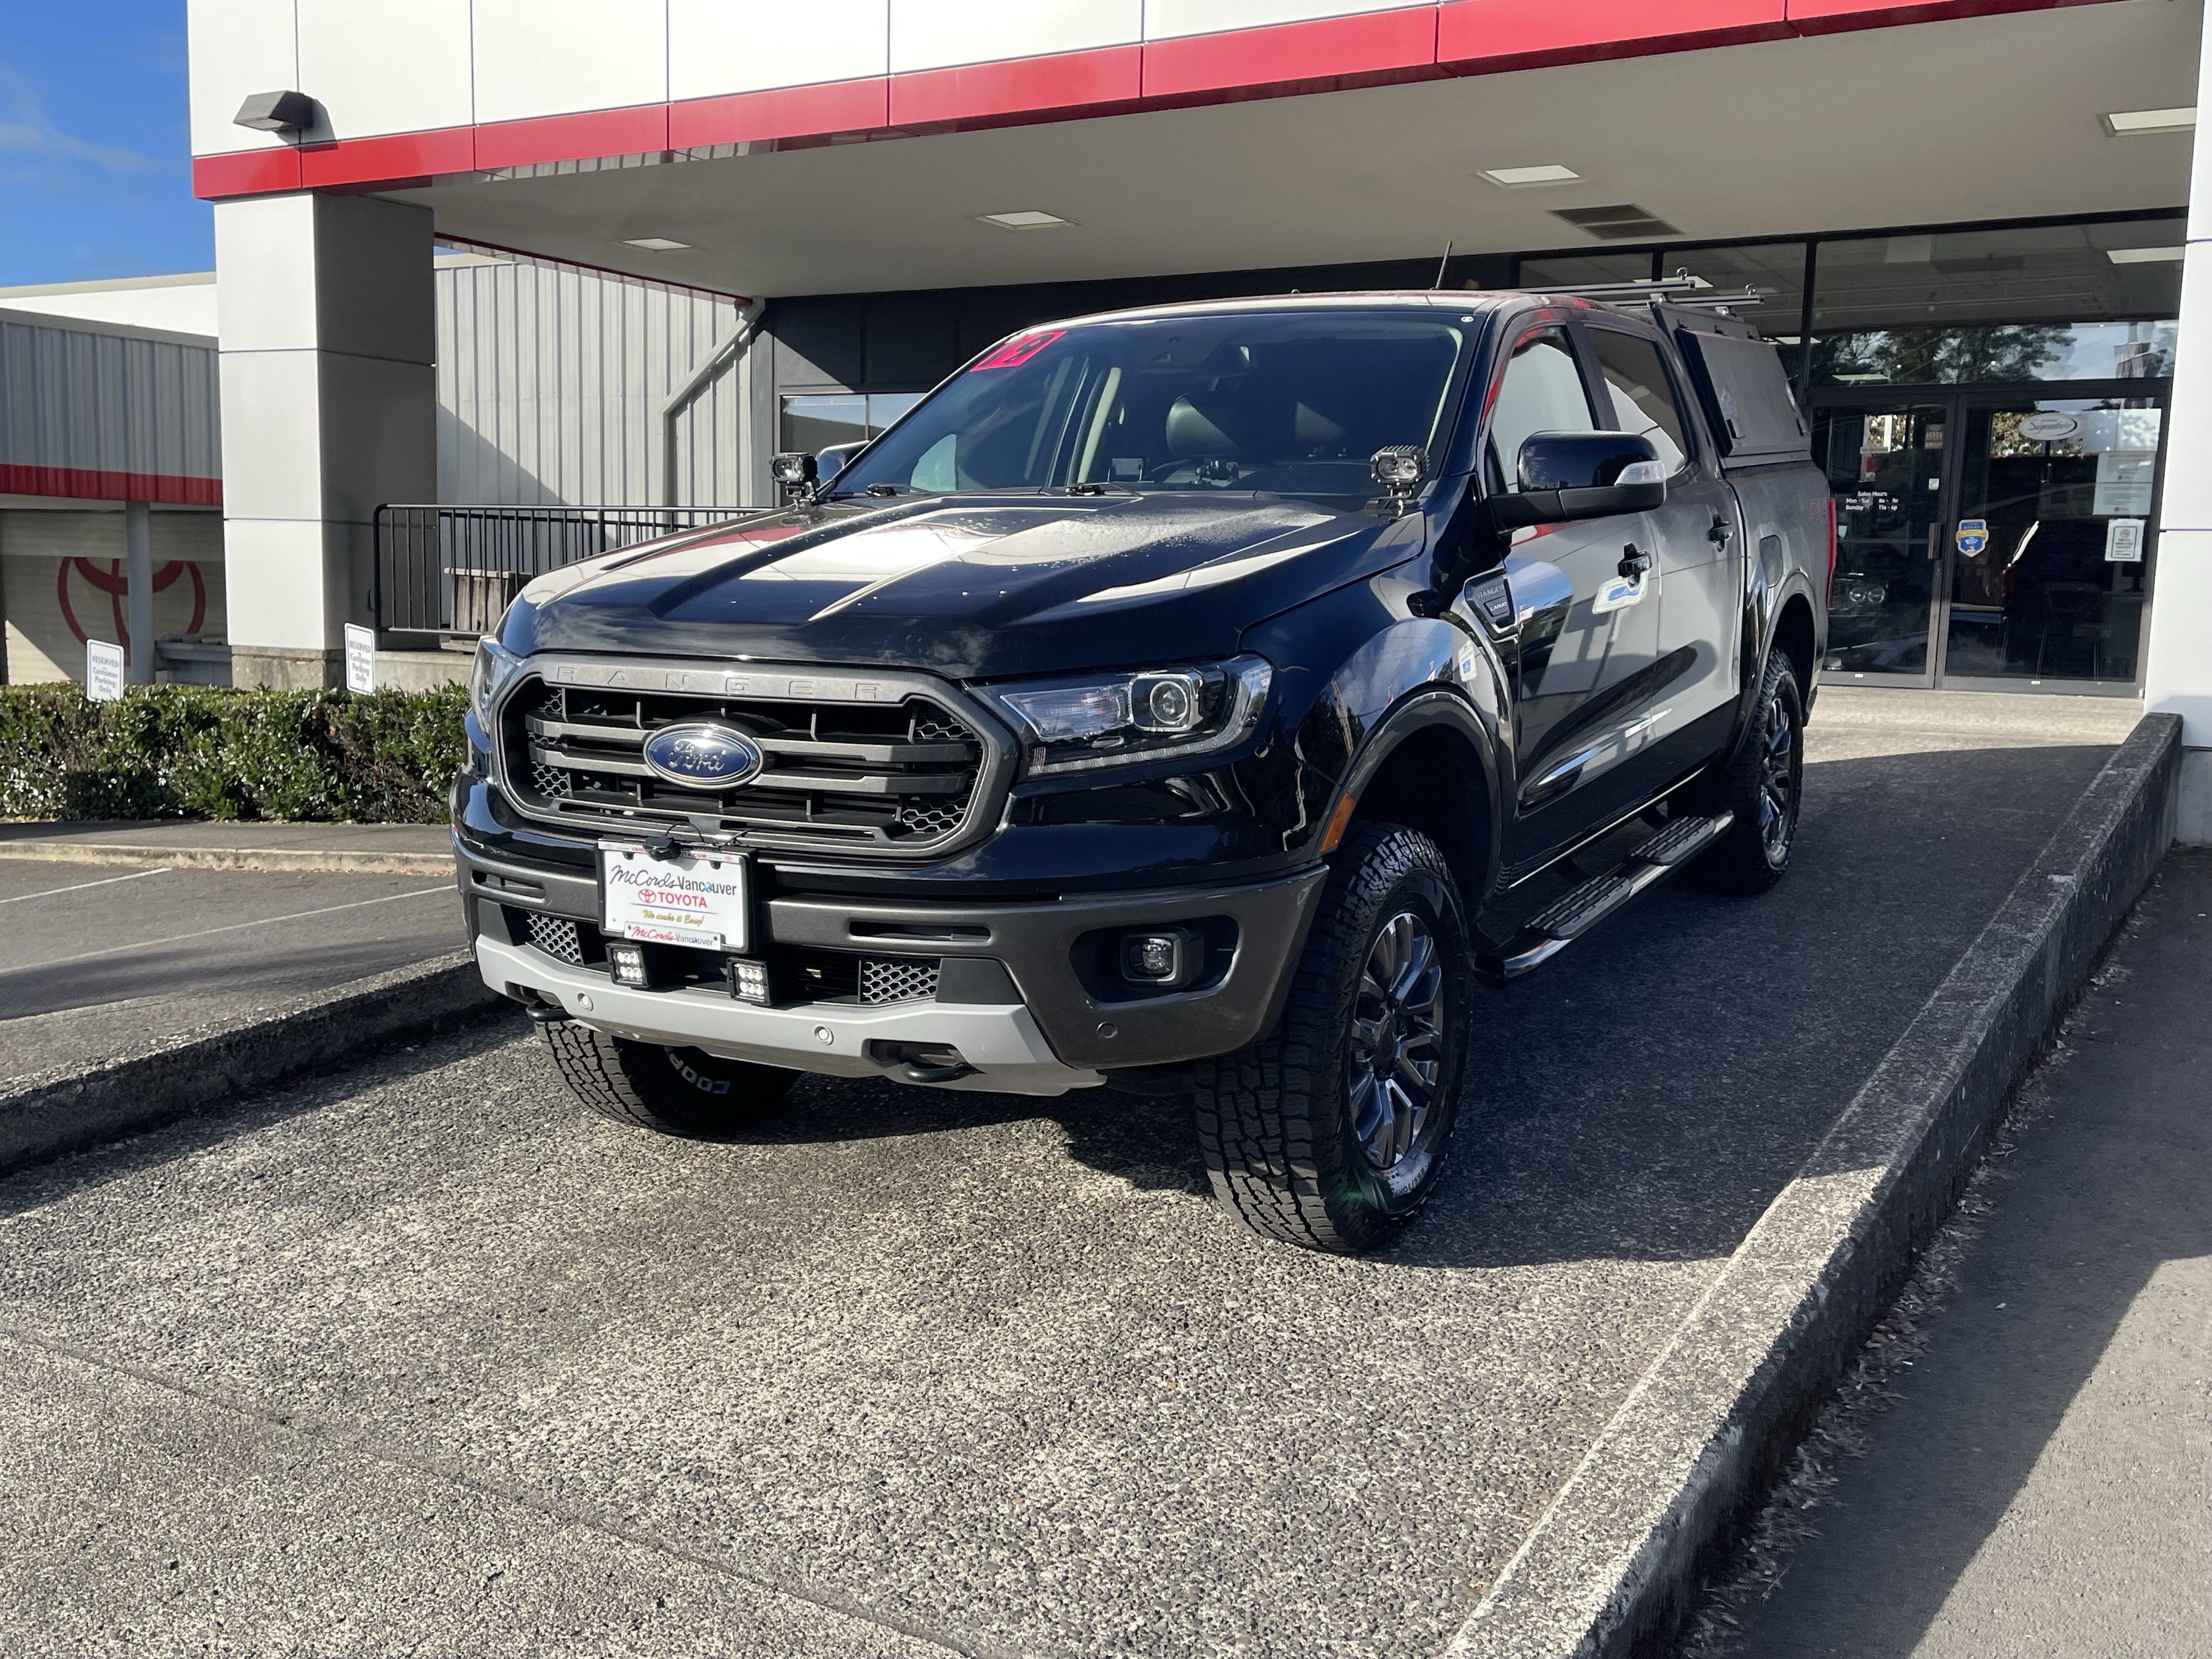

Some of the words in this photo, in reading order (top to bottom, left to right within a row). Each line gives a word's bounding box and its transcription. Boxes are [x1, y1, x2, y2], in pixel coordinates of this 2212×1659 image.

[1477, 585, 1504, 599] RANGER
[349, 641, 371, 653] RESERVED
[93, 656, 119, 668] RESERVED
[350, 653, 371, 665] Customer
[93, 666, 118, 679] Customer
[352, 662, 370, 677] Parking
[95, 675, 116, 689] Parking
[356, 673, 366, 684] Only
[557, 666, 882, 699] RANGER
[668, 738, 726, 772] Ford
[658, 891, 708, 908] TOYOTA
